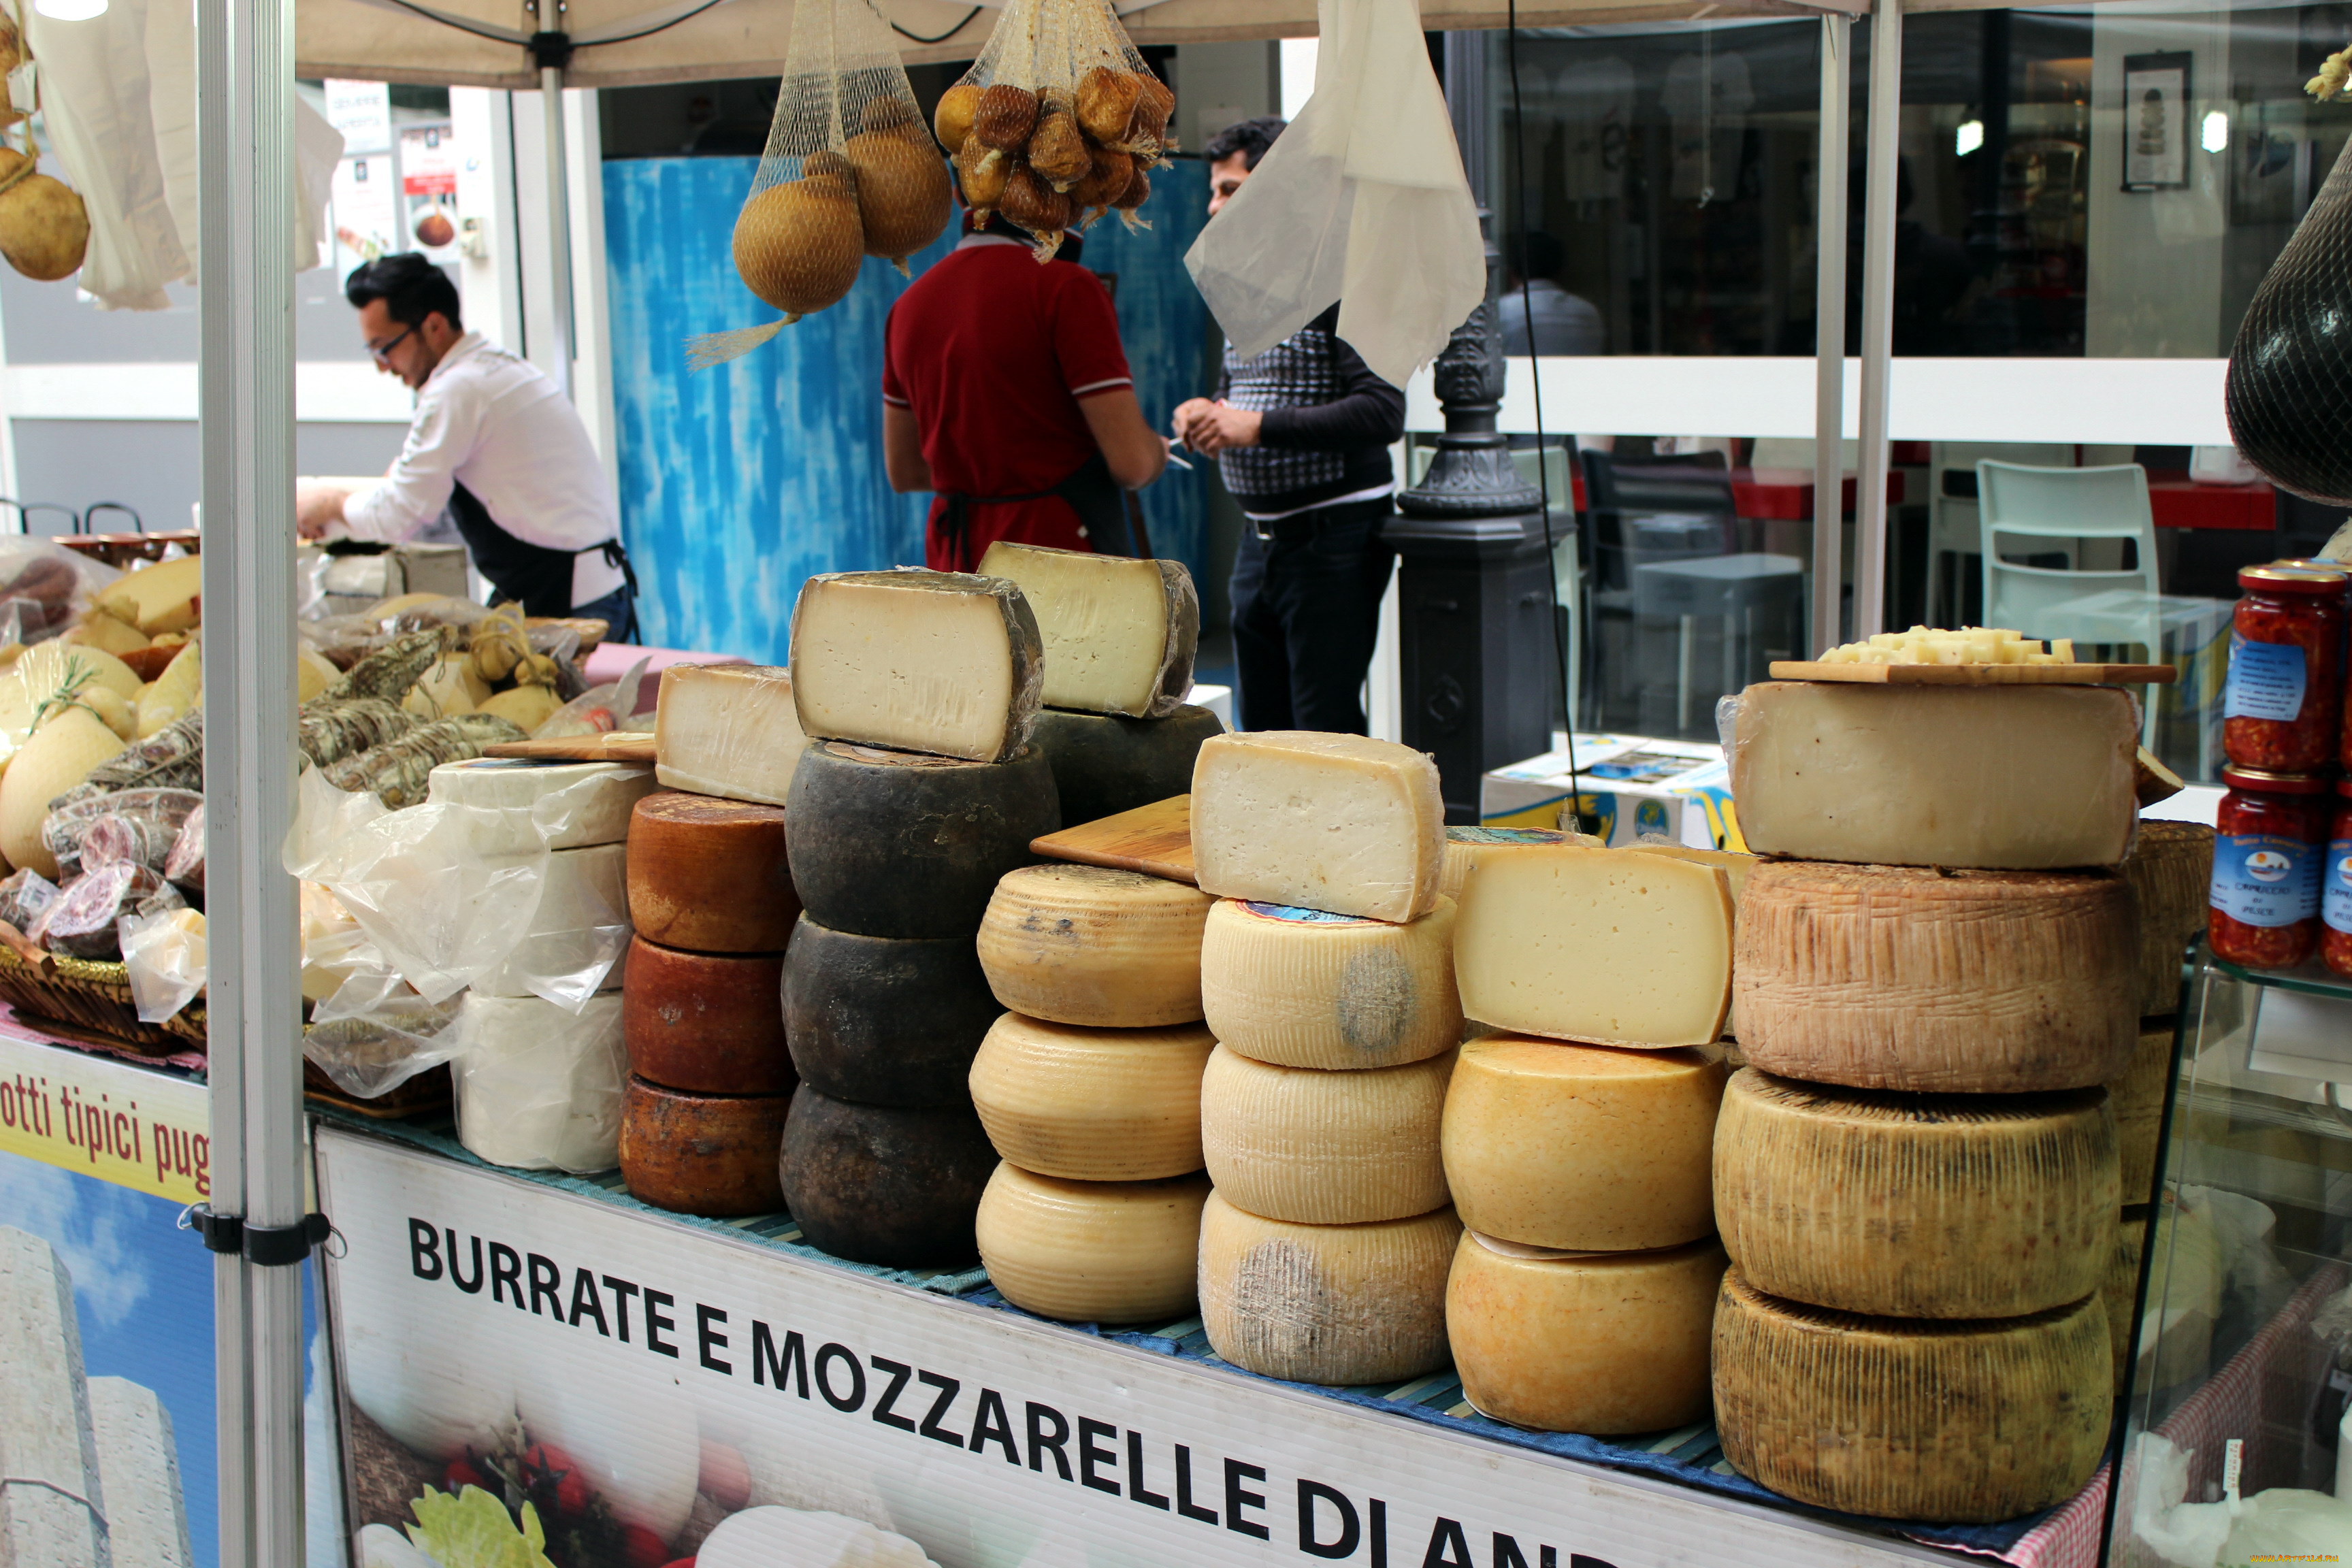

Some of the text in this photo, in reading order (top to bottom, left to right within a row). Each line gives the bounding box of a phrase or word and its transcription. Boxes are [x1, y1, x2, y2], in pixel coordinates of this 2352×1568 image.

[0, 1073, 52, 1138] otti
[61, 1085, 142, 1164] tipici
[408, 1218, 679, 1358] BURRATE
[696, 1303, 732, 1375] E
[752, 1320, 1270, 1541] MOZZARELLE
[1297, 1478, 1387, 1568] DI
